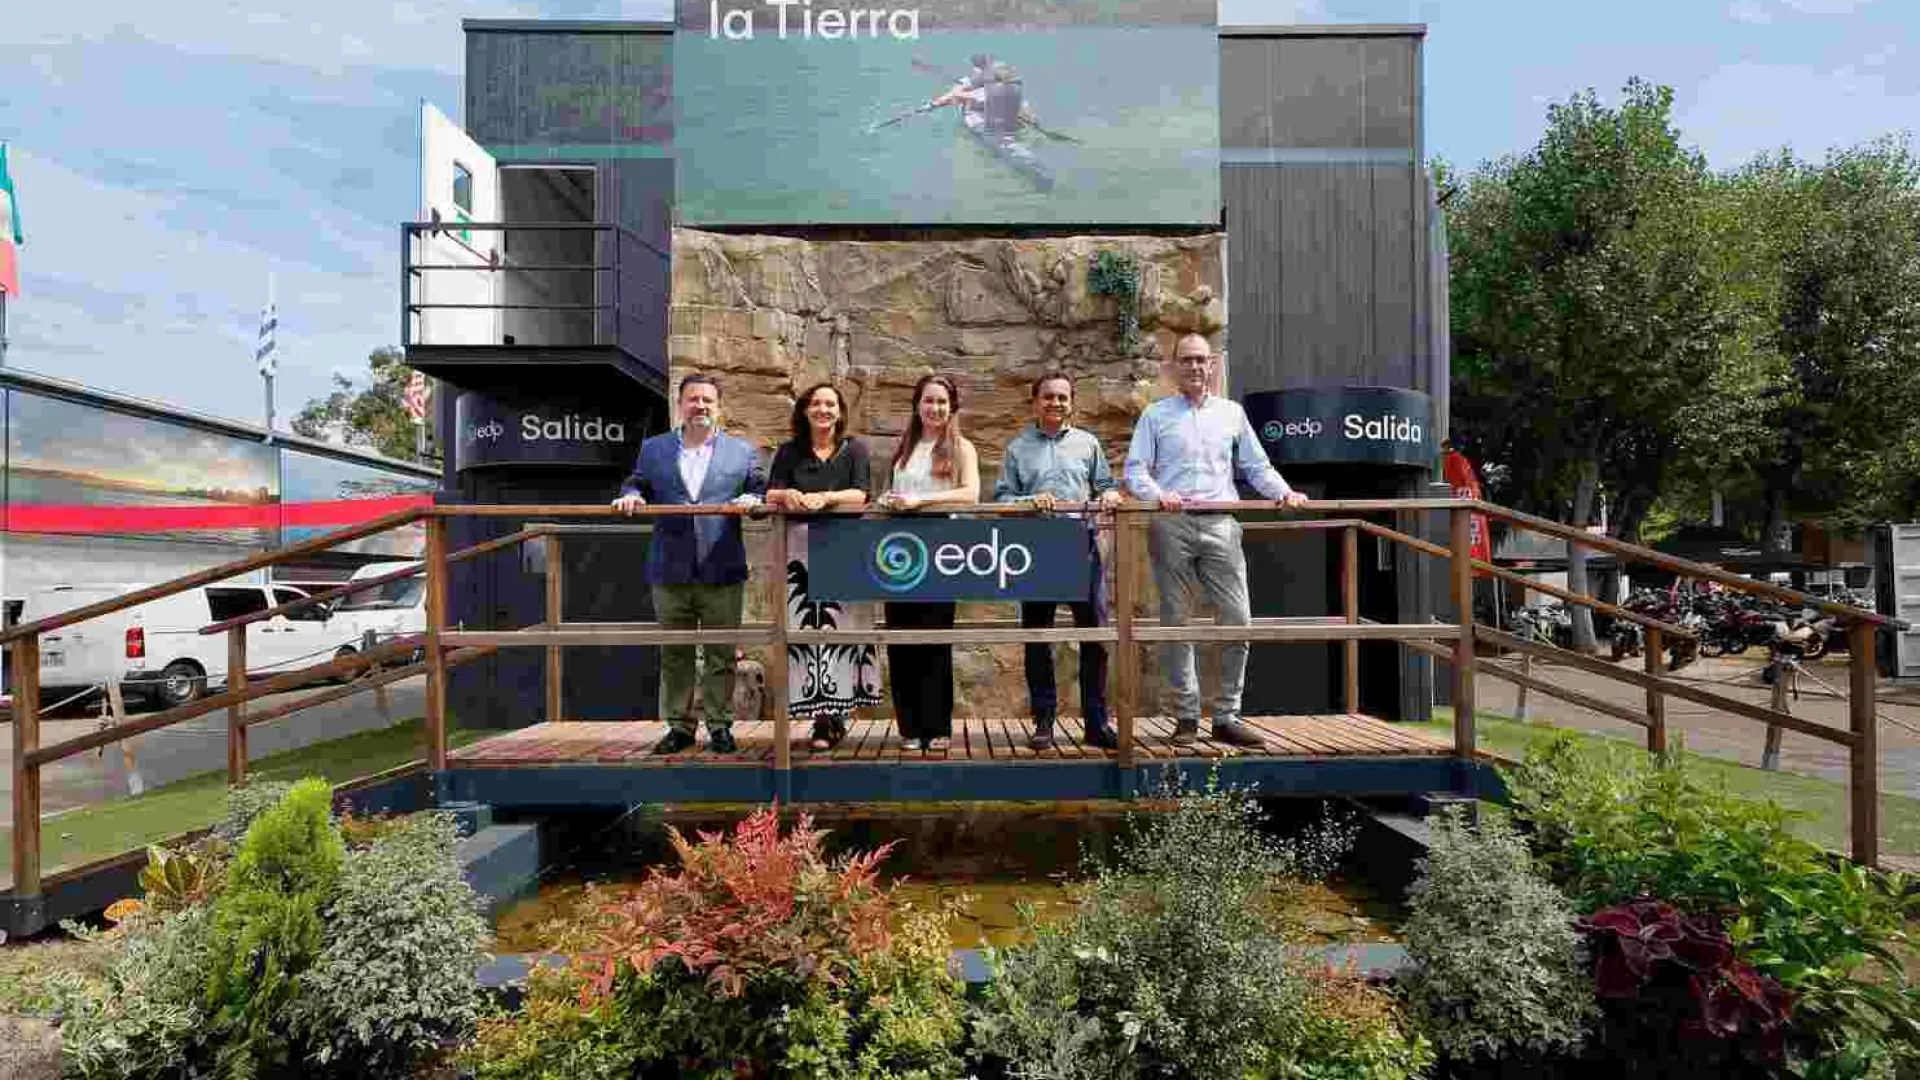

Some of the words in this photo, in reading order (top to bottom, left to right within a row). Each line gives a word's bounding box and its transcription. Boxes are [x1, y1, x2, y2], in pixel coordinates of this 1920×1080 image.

[710, 0, 754, 39] la
[766, 0, 920, 40] Tierra
[477, 417, 504, 442] edp
[521, 413, 625, 442] Salida
[1285, 417, 1323, 438] edp
[1344, 414, 1422, 443] Salida
[934, 527, 1032, 589] edp
